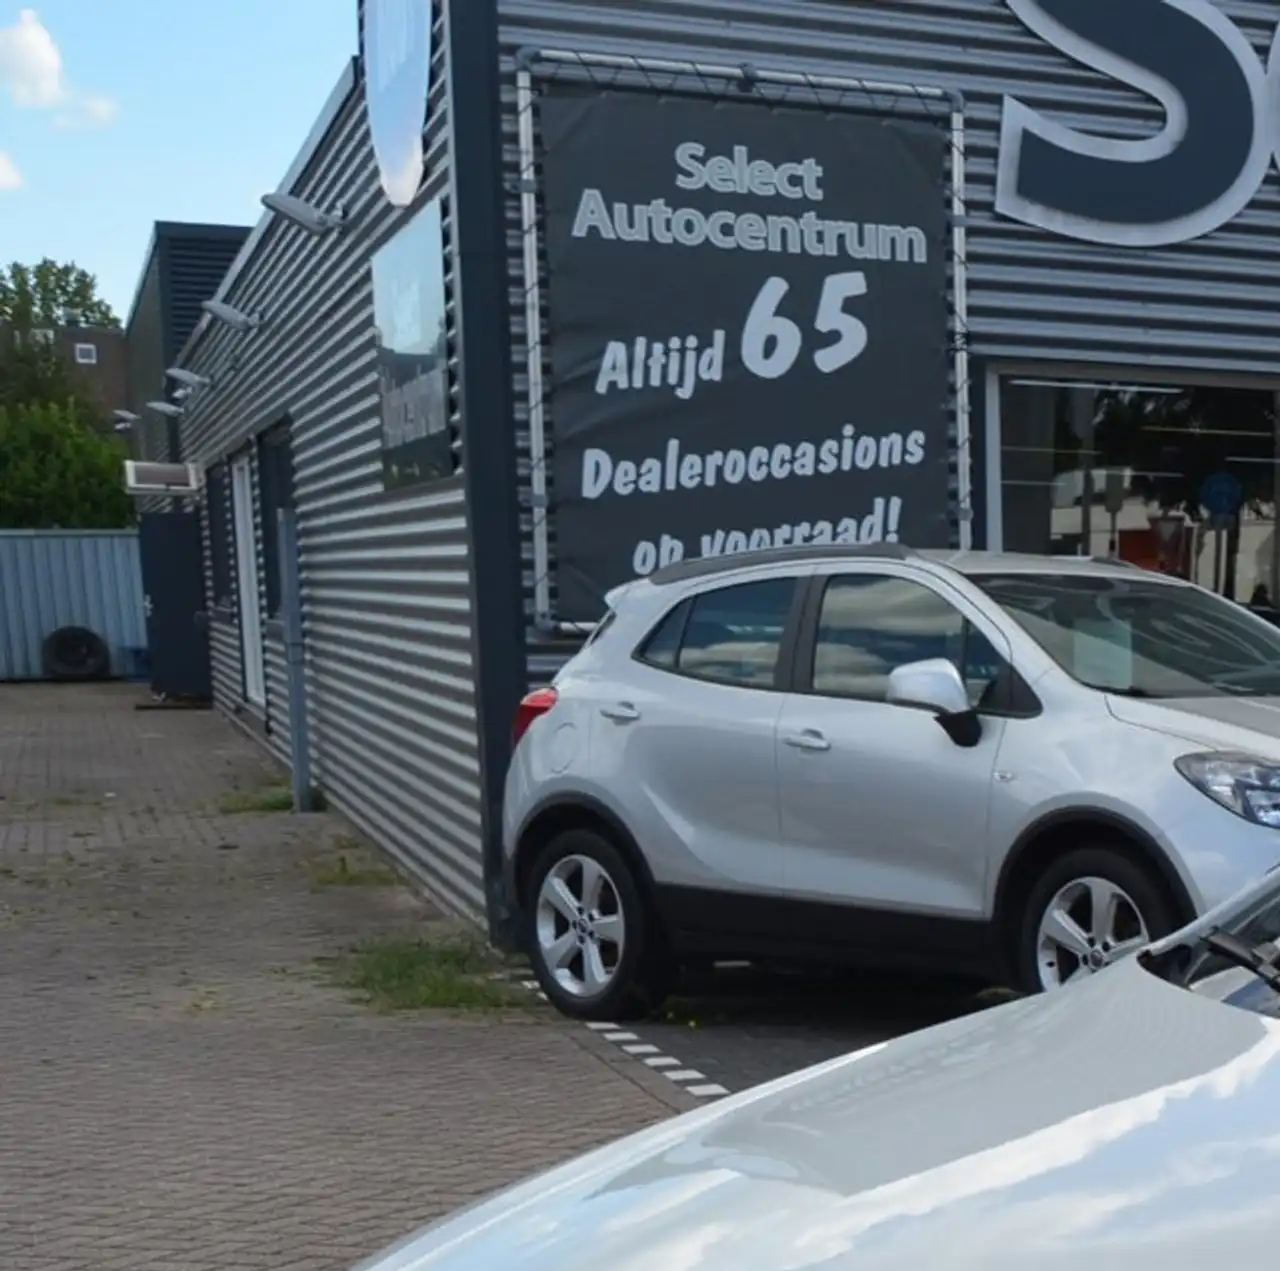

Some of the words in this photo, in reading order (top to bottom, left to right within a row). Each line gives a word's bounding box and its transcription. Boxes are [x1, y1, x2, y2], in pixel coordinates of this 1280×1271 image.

[674, 141, 824, 201] Select
[571, 188, 928, 263] Autocentrum
[595, 329, 725, 400] Altijd
[741, 271, 867, 379] 65
[581, 423, 925, 499] Dealeroccasions
